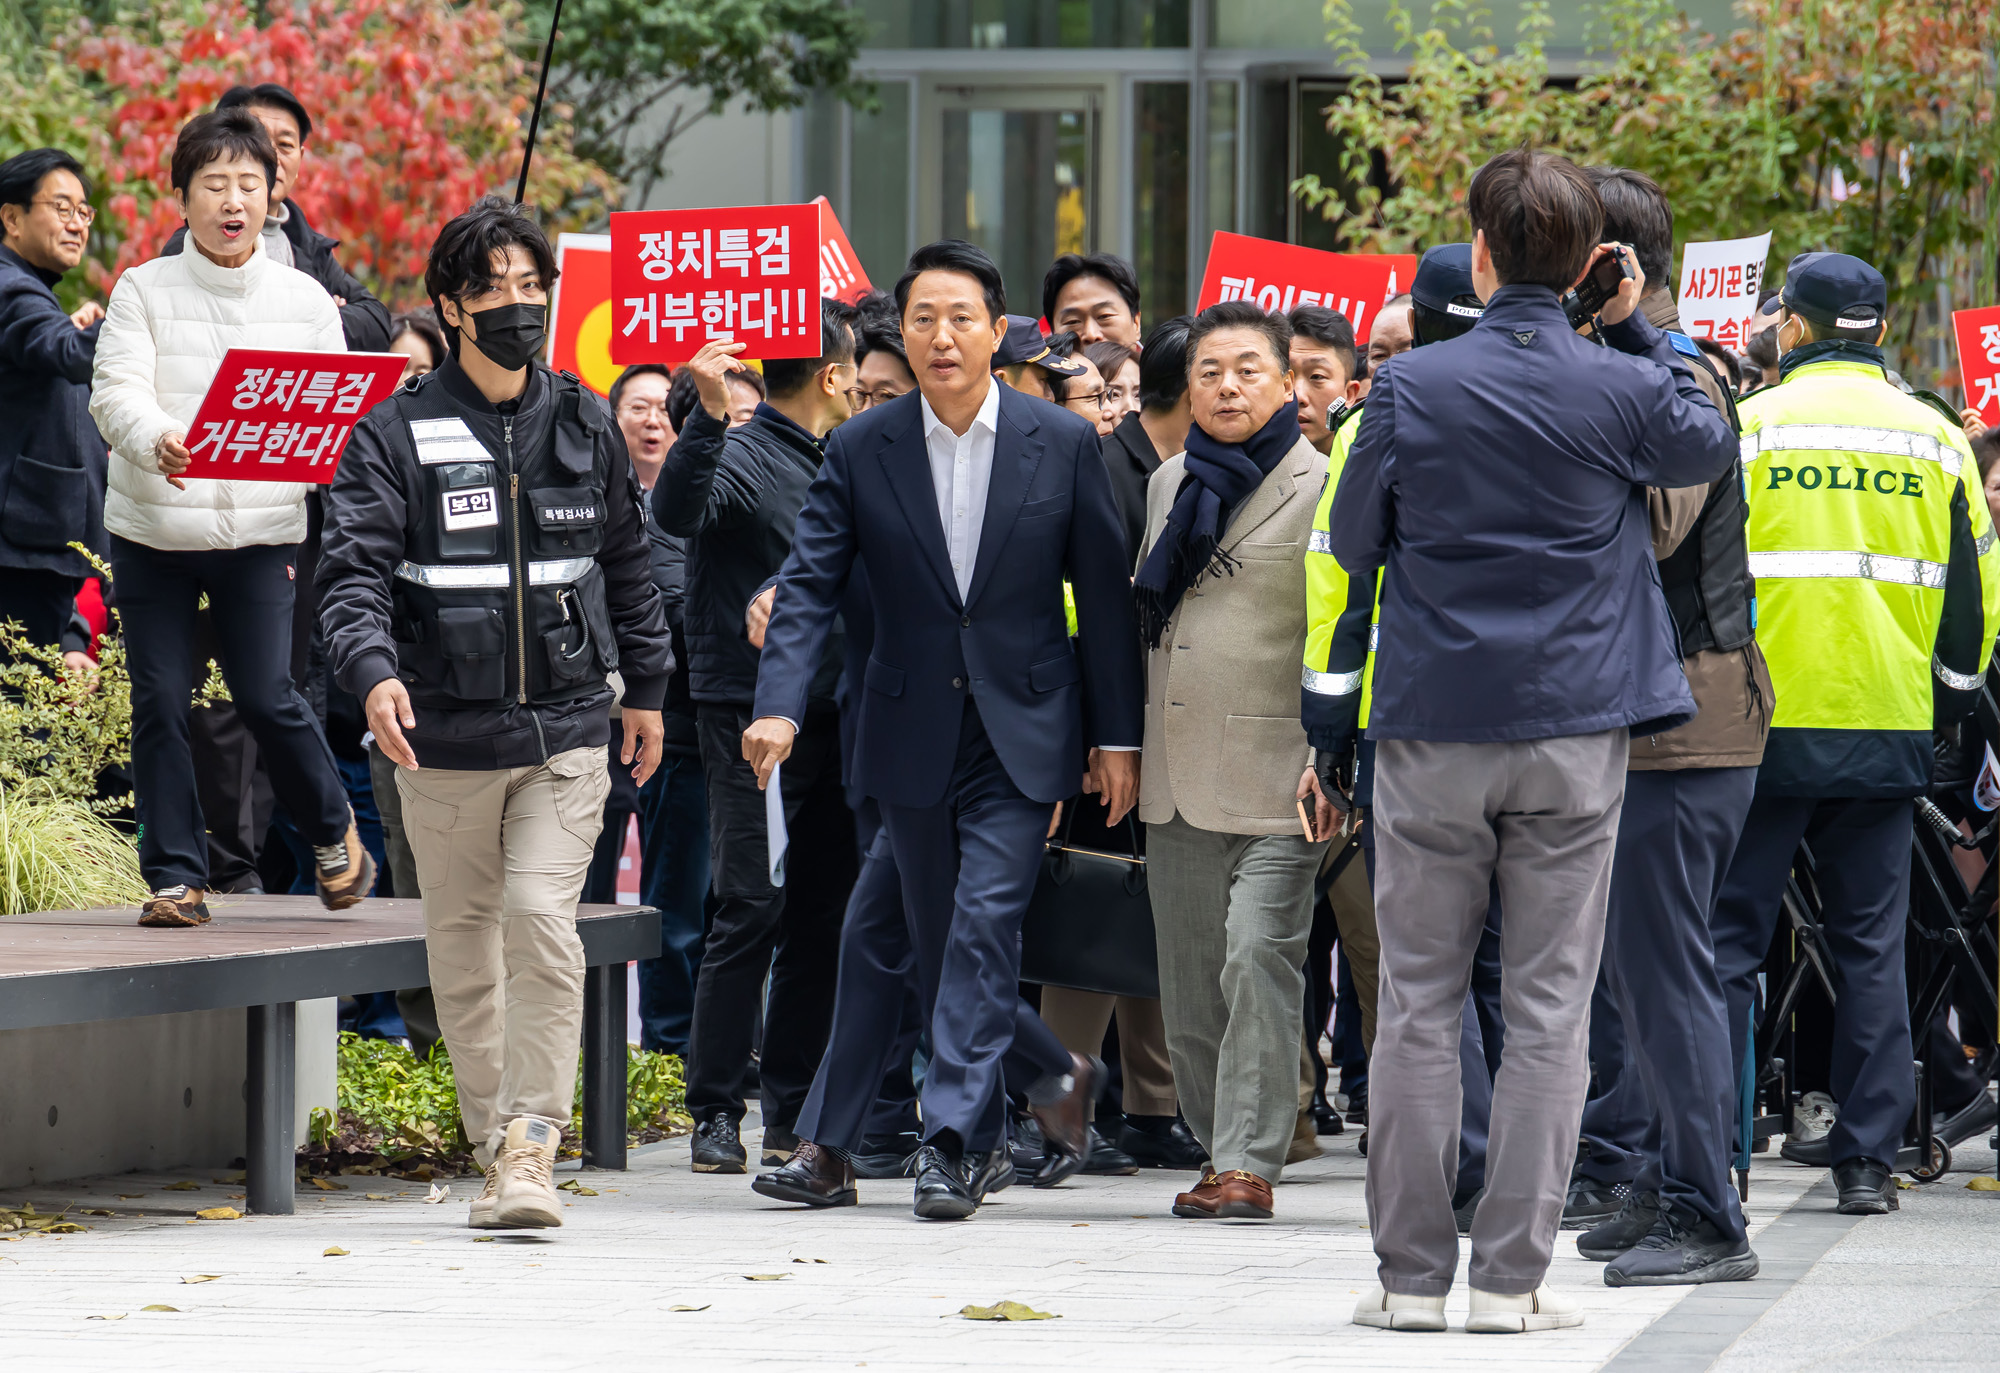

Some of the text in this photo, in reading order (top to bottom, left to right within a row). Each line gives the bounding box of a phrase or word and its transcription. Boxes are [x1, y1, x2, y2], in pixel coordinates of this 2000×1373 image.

[638, 226, 790, 281] 정치특검
[1685, 265, 1742, 299] 사기꾼
[622, 288, 806, 343] 거부한다!!
[1452, 306, 1485, 316] POLIC
[1840, 319, 1875, 327] POLICE
[232, 368, 376, 414] 정치특검
[190, 419, 350, 466] 거부한다!
[1766, 465, 1924, 498] POLICE
[451, 493, 489, 512] 보안
[545, 507, 596, 521] 특별검사실
